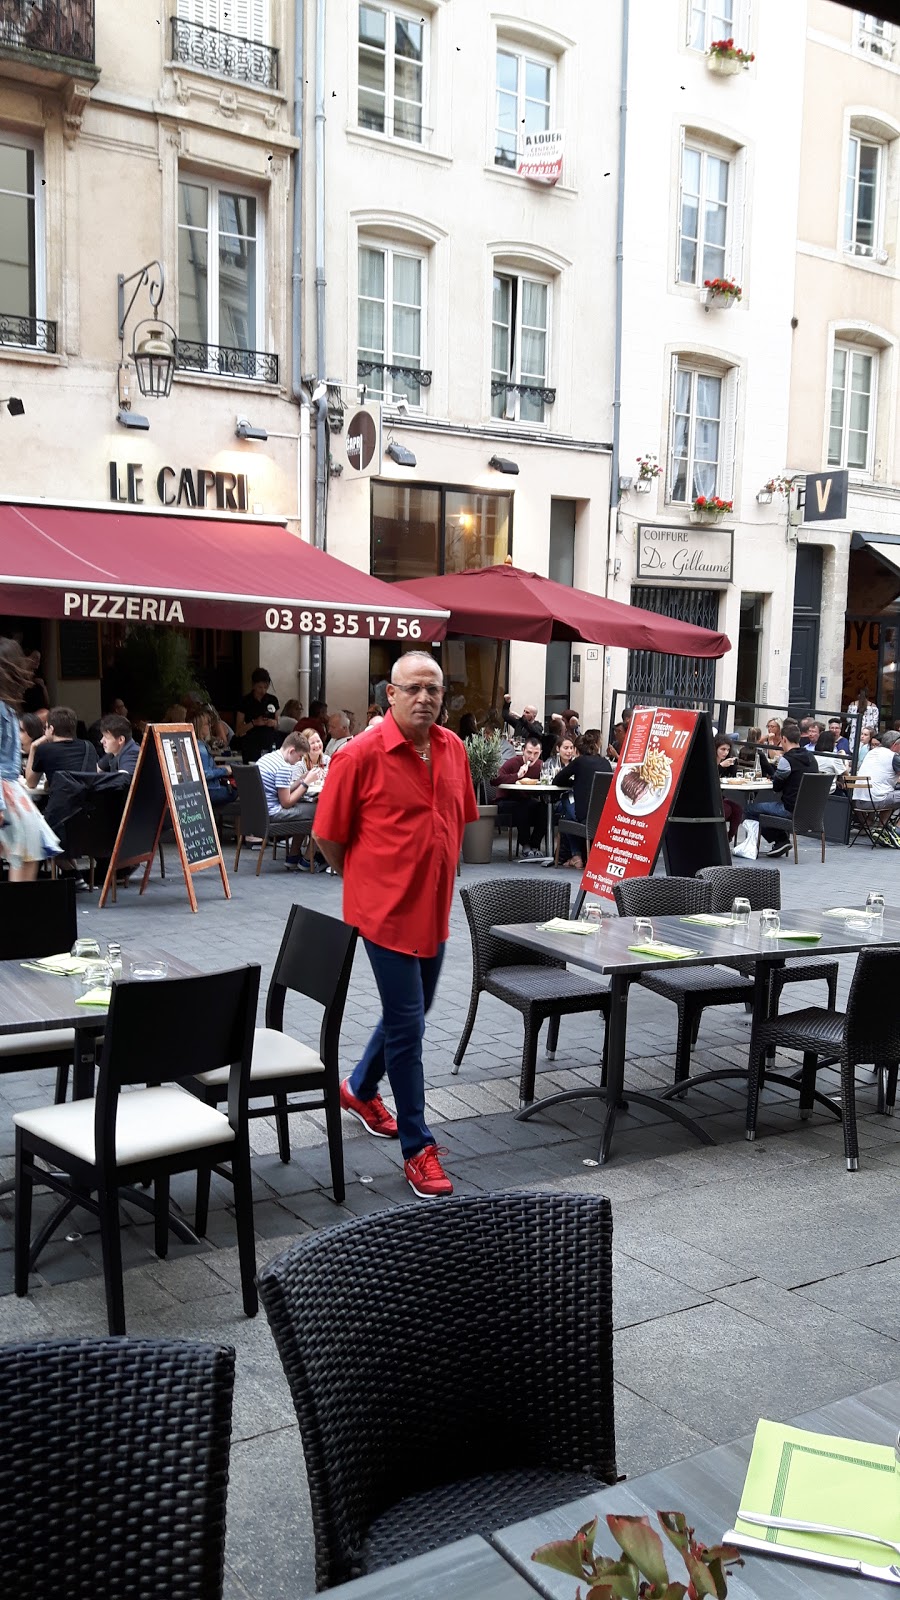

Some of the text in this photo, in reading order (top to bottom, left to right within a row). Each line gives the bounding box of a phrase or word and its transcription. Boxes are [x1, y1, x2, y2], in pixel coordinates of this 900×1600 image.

[534, 133, 562, 144] LOUER
[109, 461, 249, 513] LE CAPRI
[815, 478, 833, 513] V
[643, 529, 689, 543] COIFFURE
[641, 545, 731, 576] De Gillaumé
[63, 592, 185, 623] PIZZERIA
[265, 607, 422, 639] 03 83 35 17 56
[671, 730, 690, 749] 7/7
[616, 814, 631, 825] Salade
[630, 818, 637, 826] de
[611, 825, 621, 834] Faux
[624, 838, 639, 847] maison
[632, 852, 649, 863] maison
[608, 864, 624, 876] 17€
